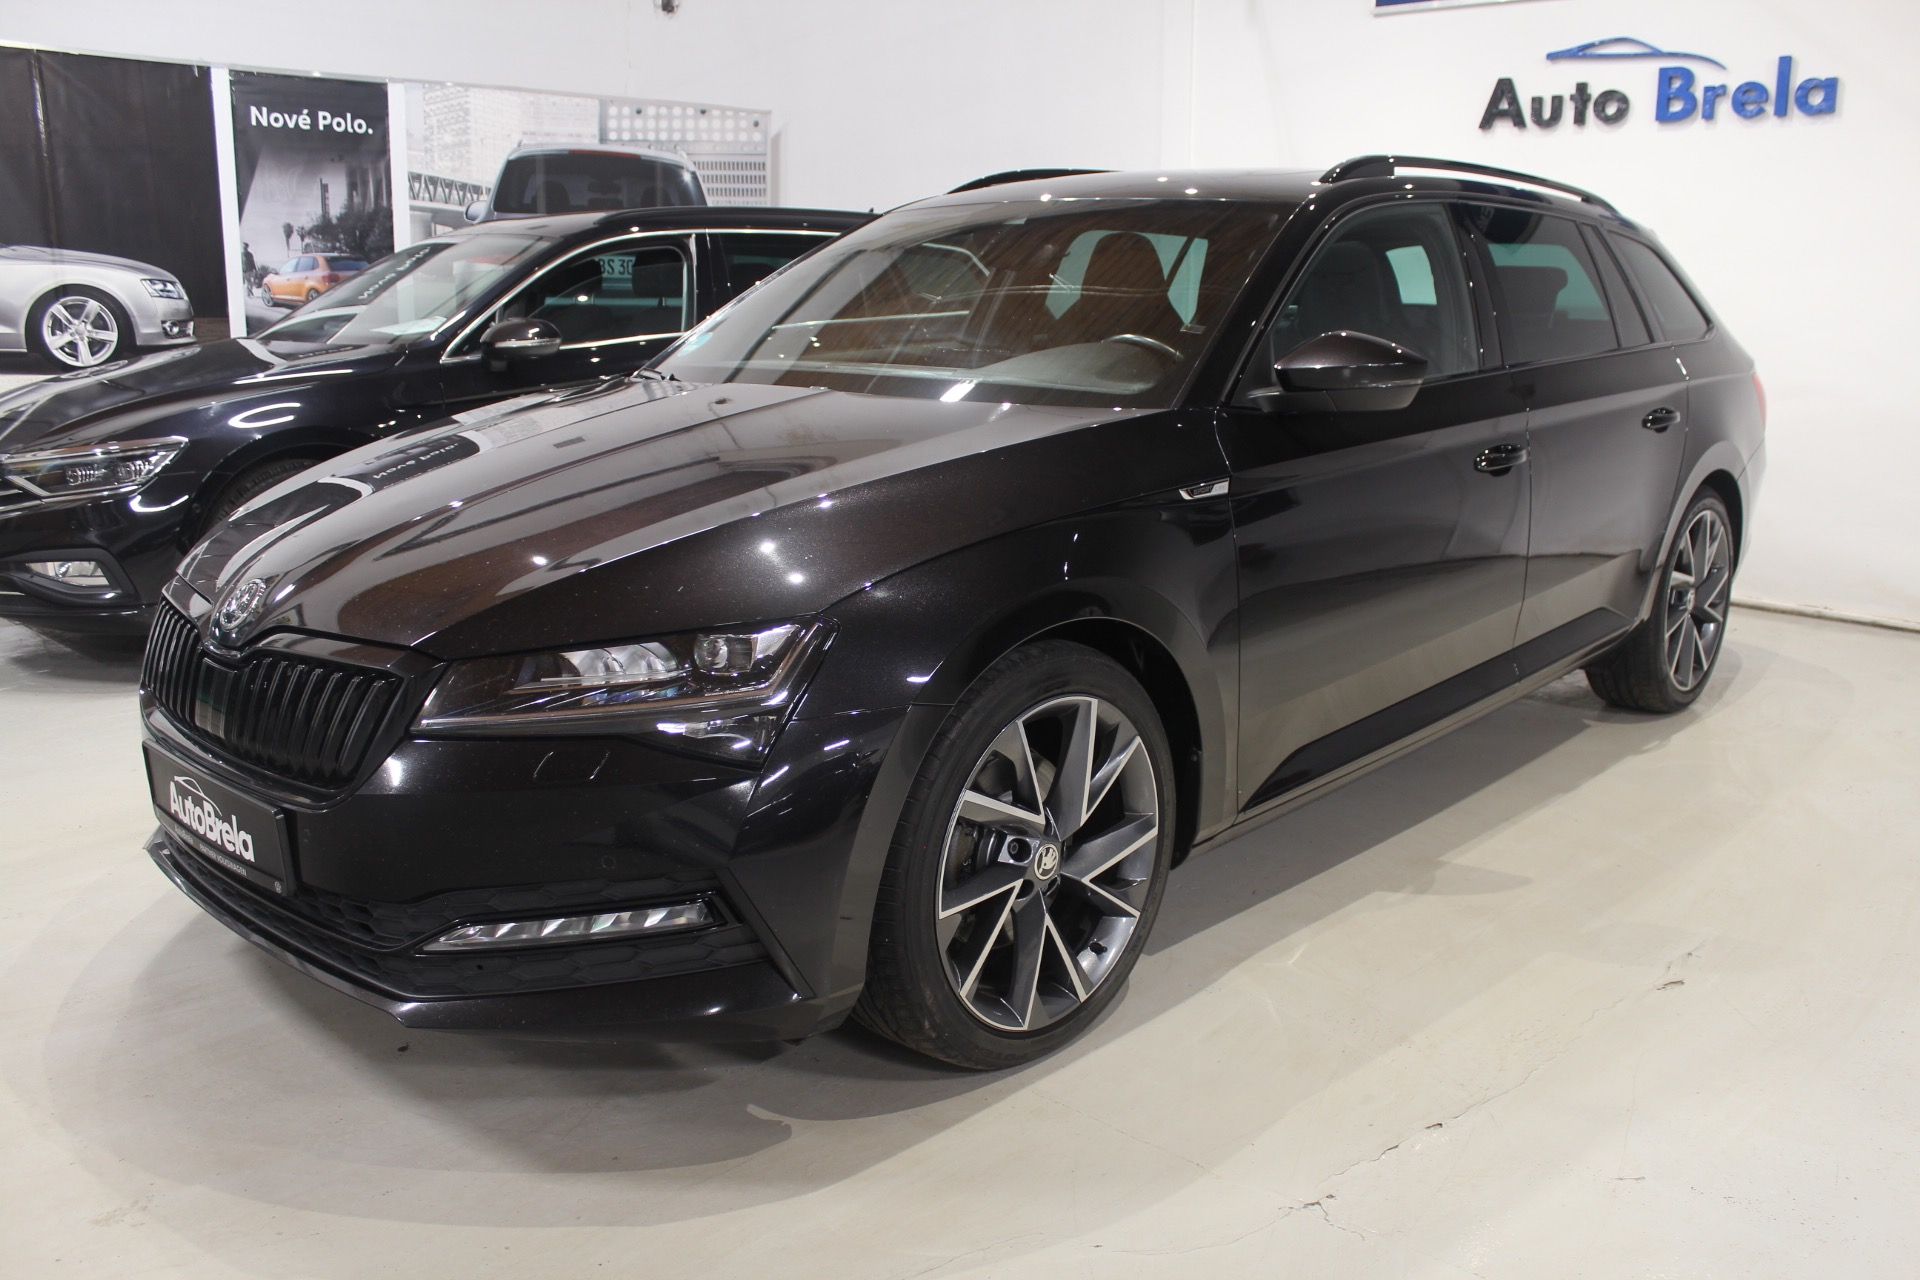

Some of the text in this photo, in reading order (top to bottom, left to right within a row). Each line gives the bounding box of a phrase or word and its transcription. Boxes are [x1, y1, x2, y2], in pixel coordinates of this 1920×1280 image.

[250, 105, 374, 135] Nové Polo.
[1479, 56, 1839, 130] Auto Brela
[169, 781, 255, 863] AutoBrela
